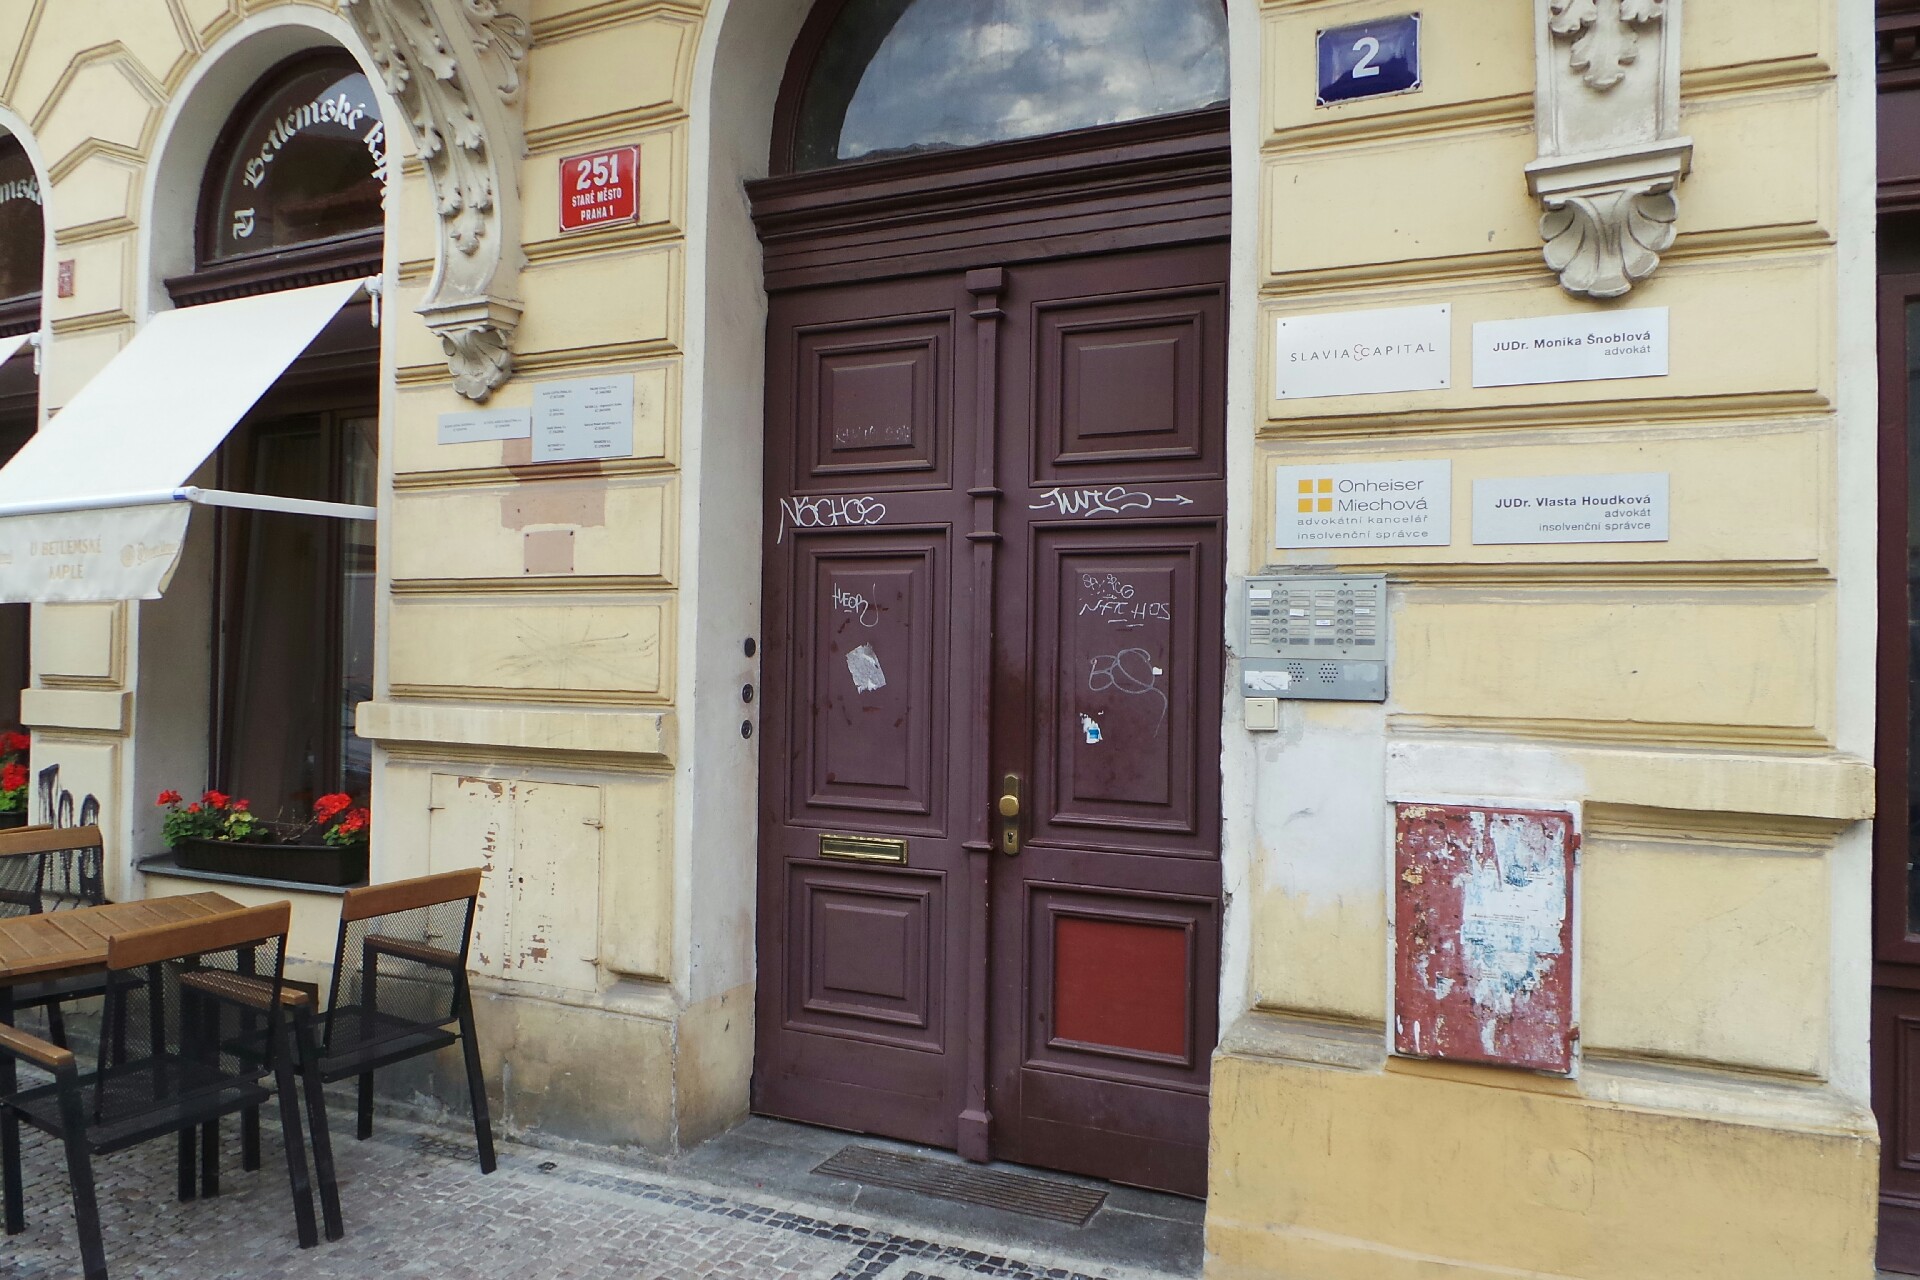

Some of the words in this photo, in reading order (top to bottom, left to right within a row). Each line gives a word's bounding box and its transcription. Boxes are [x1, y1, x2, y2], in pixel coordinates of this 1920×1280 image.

[1352, 36, 1380, 79] 2
[576, 153, 619, 191] 251
[571, 189, 596, 208] STARÉ
[597, 187, 622, 203] MĚSTO
[580, 206, 607, 221] PRAHA
[609, 204, 614, 216] 1
[1492, 341, 1529, 352] JUDr.
[1534, 337, 1582, 349] Monika
[1587, 330, 1651, 345] Šnoblová
[1290, 349, 1350, 363] SLAVIA
[1360, 343, 1436, 357] CAPITAL
[1604, 345, 1651, 356] advokát
[1338, 478, 1424, 493] Onheiser
[1338, 497, 1428, 512] Miechová
[1495, 498, 1531, 509] JUDr.
[1536, 497, 1577, 507] Vlasta
[1582, 494, 1651, 506] Houdková
[1297, 516, 1362, 526] advokátní
[1368, 515, 1428, 524] kancelář
[1604, 508, 1651, 518] advokát
[1539, 522, 1601, 532] insolvenční
[1605, 521, 1651, 532] správce
[1297, 530, 1371, 540] insolvenční
[1375, 530, 1429, 540] správce
